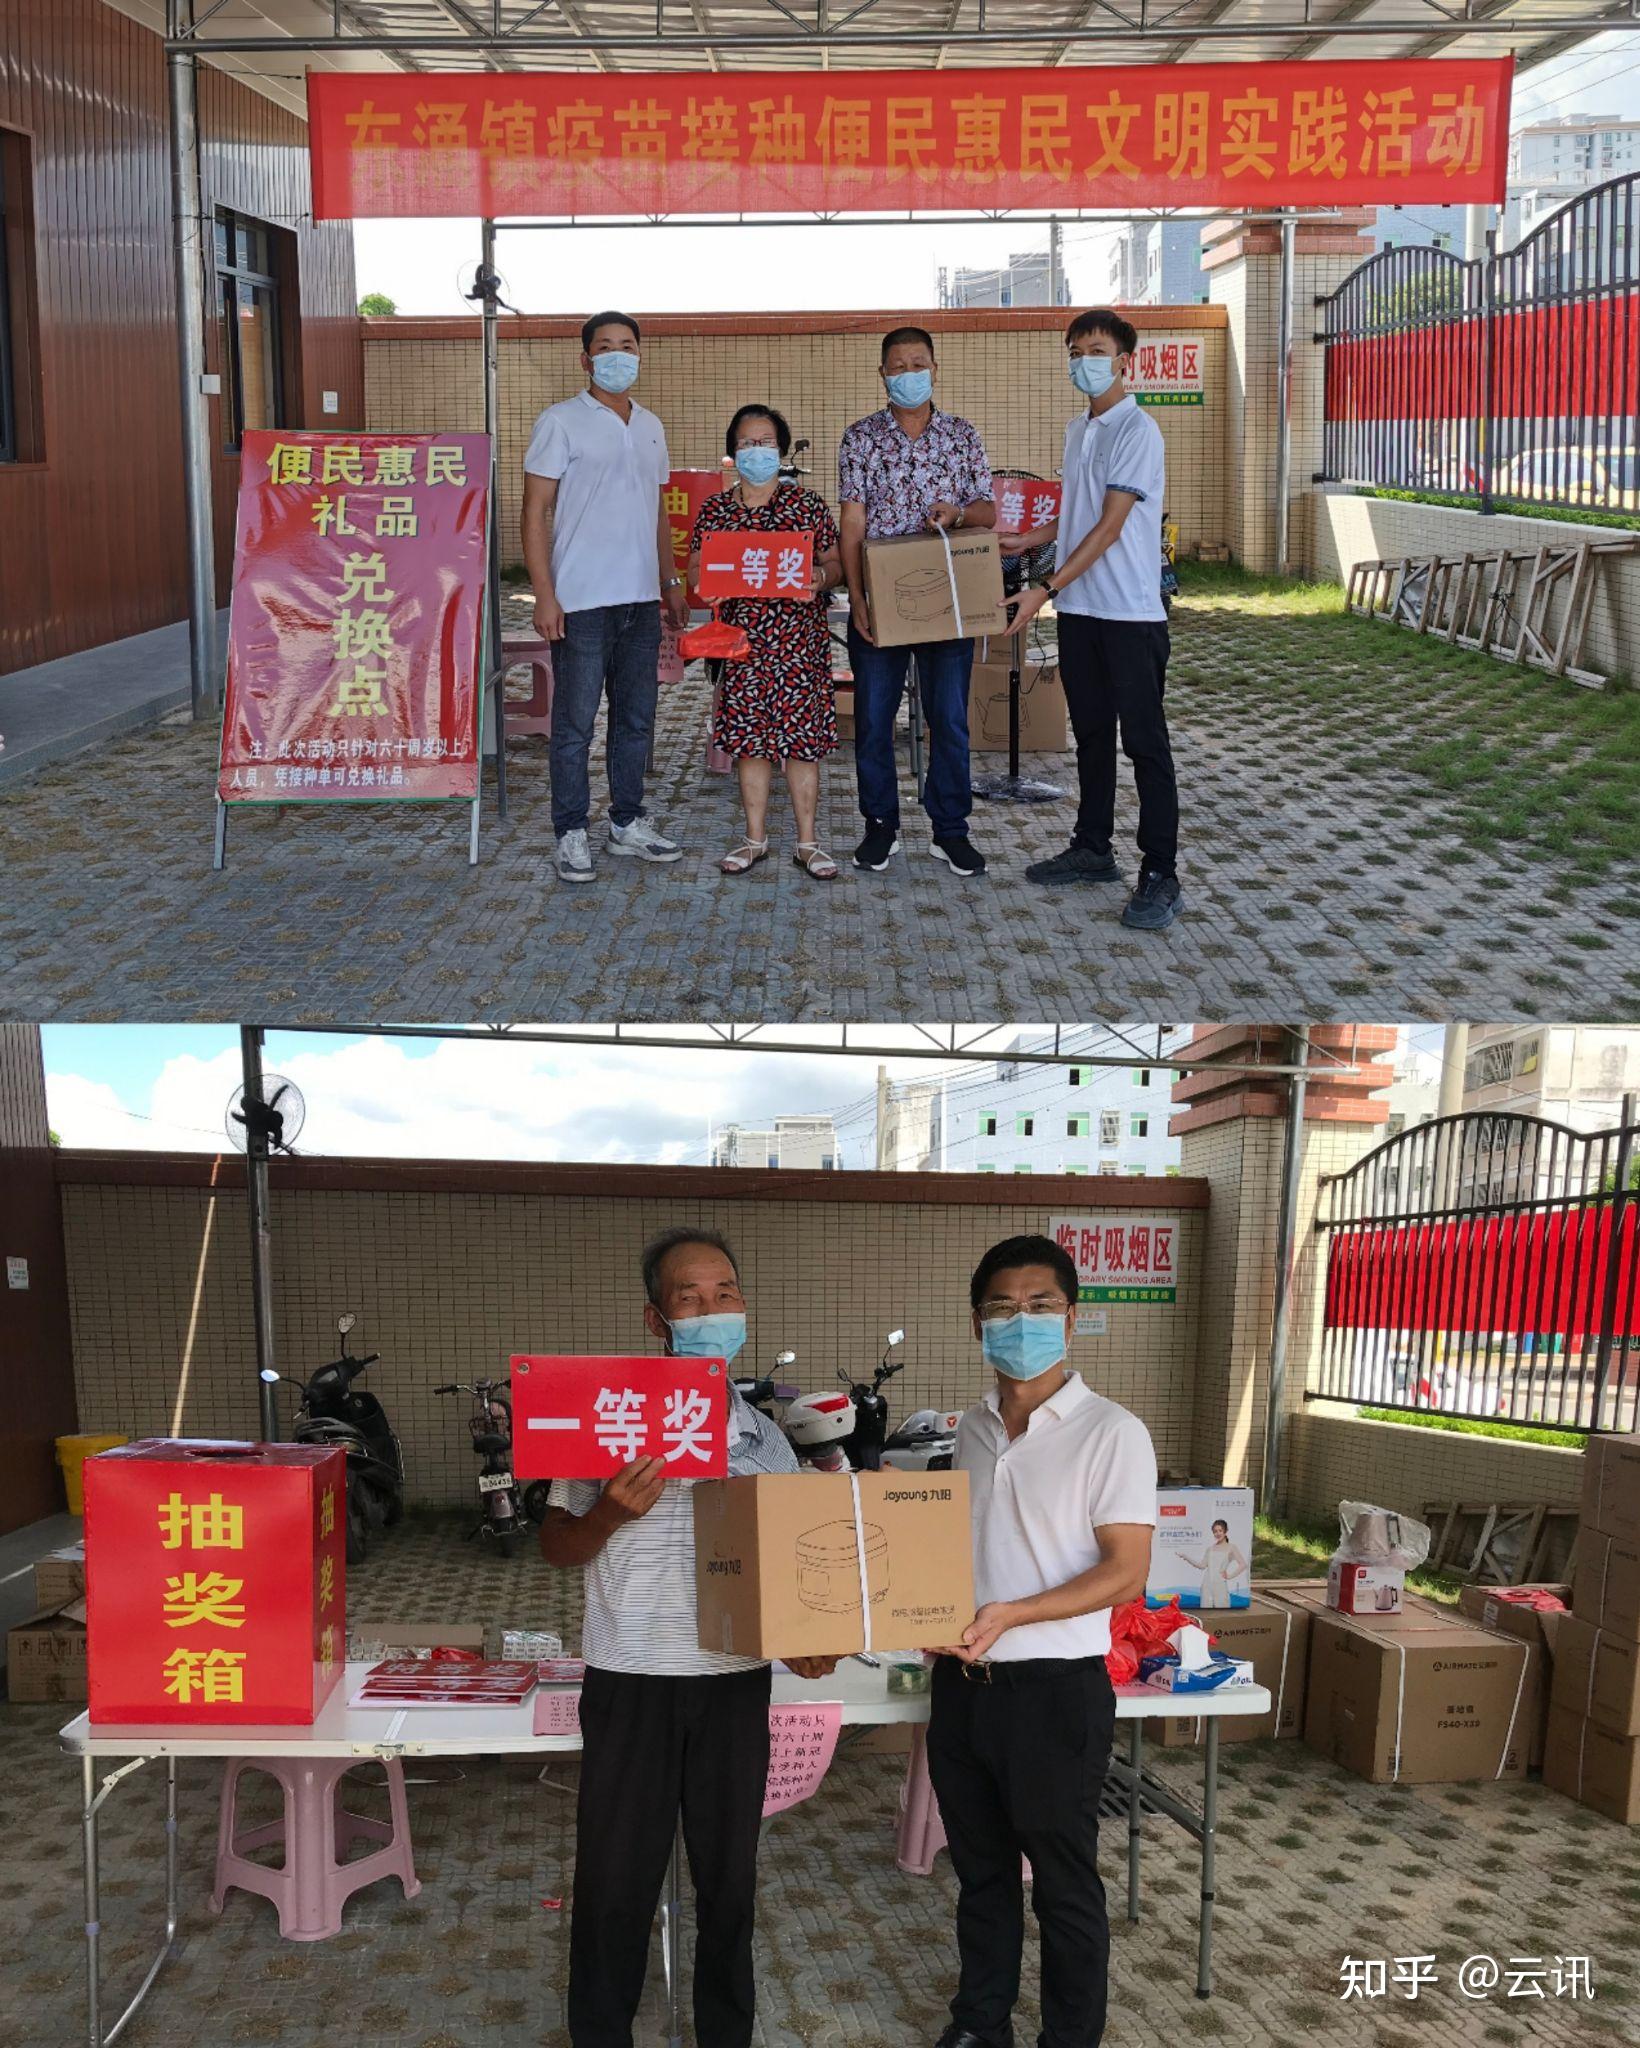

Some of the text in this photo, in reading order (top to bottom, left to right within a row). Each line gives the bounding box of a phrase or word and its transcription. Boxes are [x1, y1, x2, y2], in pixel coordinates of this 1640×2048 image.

[345, 84, 1485, 190] 东涌镇疫苗接种便民惠民文明实践活动
[267, 443, 468, 487] 便民惠民
[311, 495, 418, 537] 礼品
[707, 547, 804, 590] 一等奖
[327, 551, 395, 718] 兑换点
[1057, 1224, 1172, 1272] 临时吸烟区
[1108, 1276, 1147, 1284] SMOKING
[527, 1387, 713, 1462] 一等奖
[883, 1490, 928, 1502] Joyoung
[157, 1492, 247, 1704] 抽奖箱
